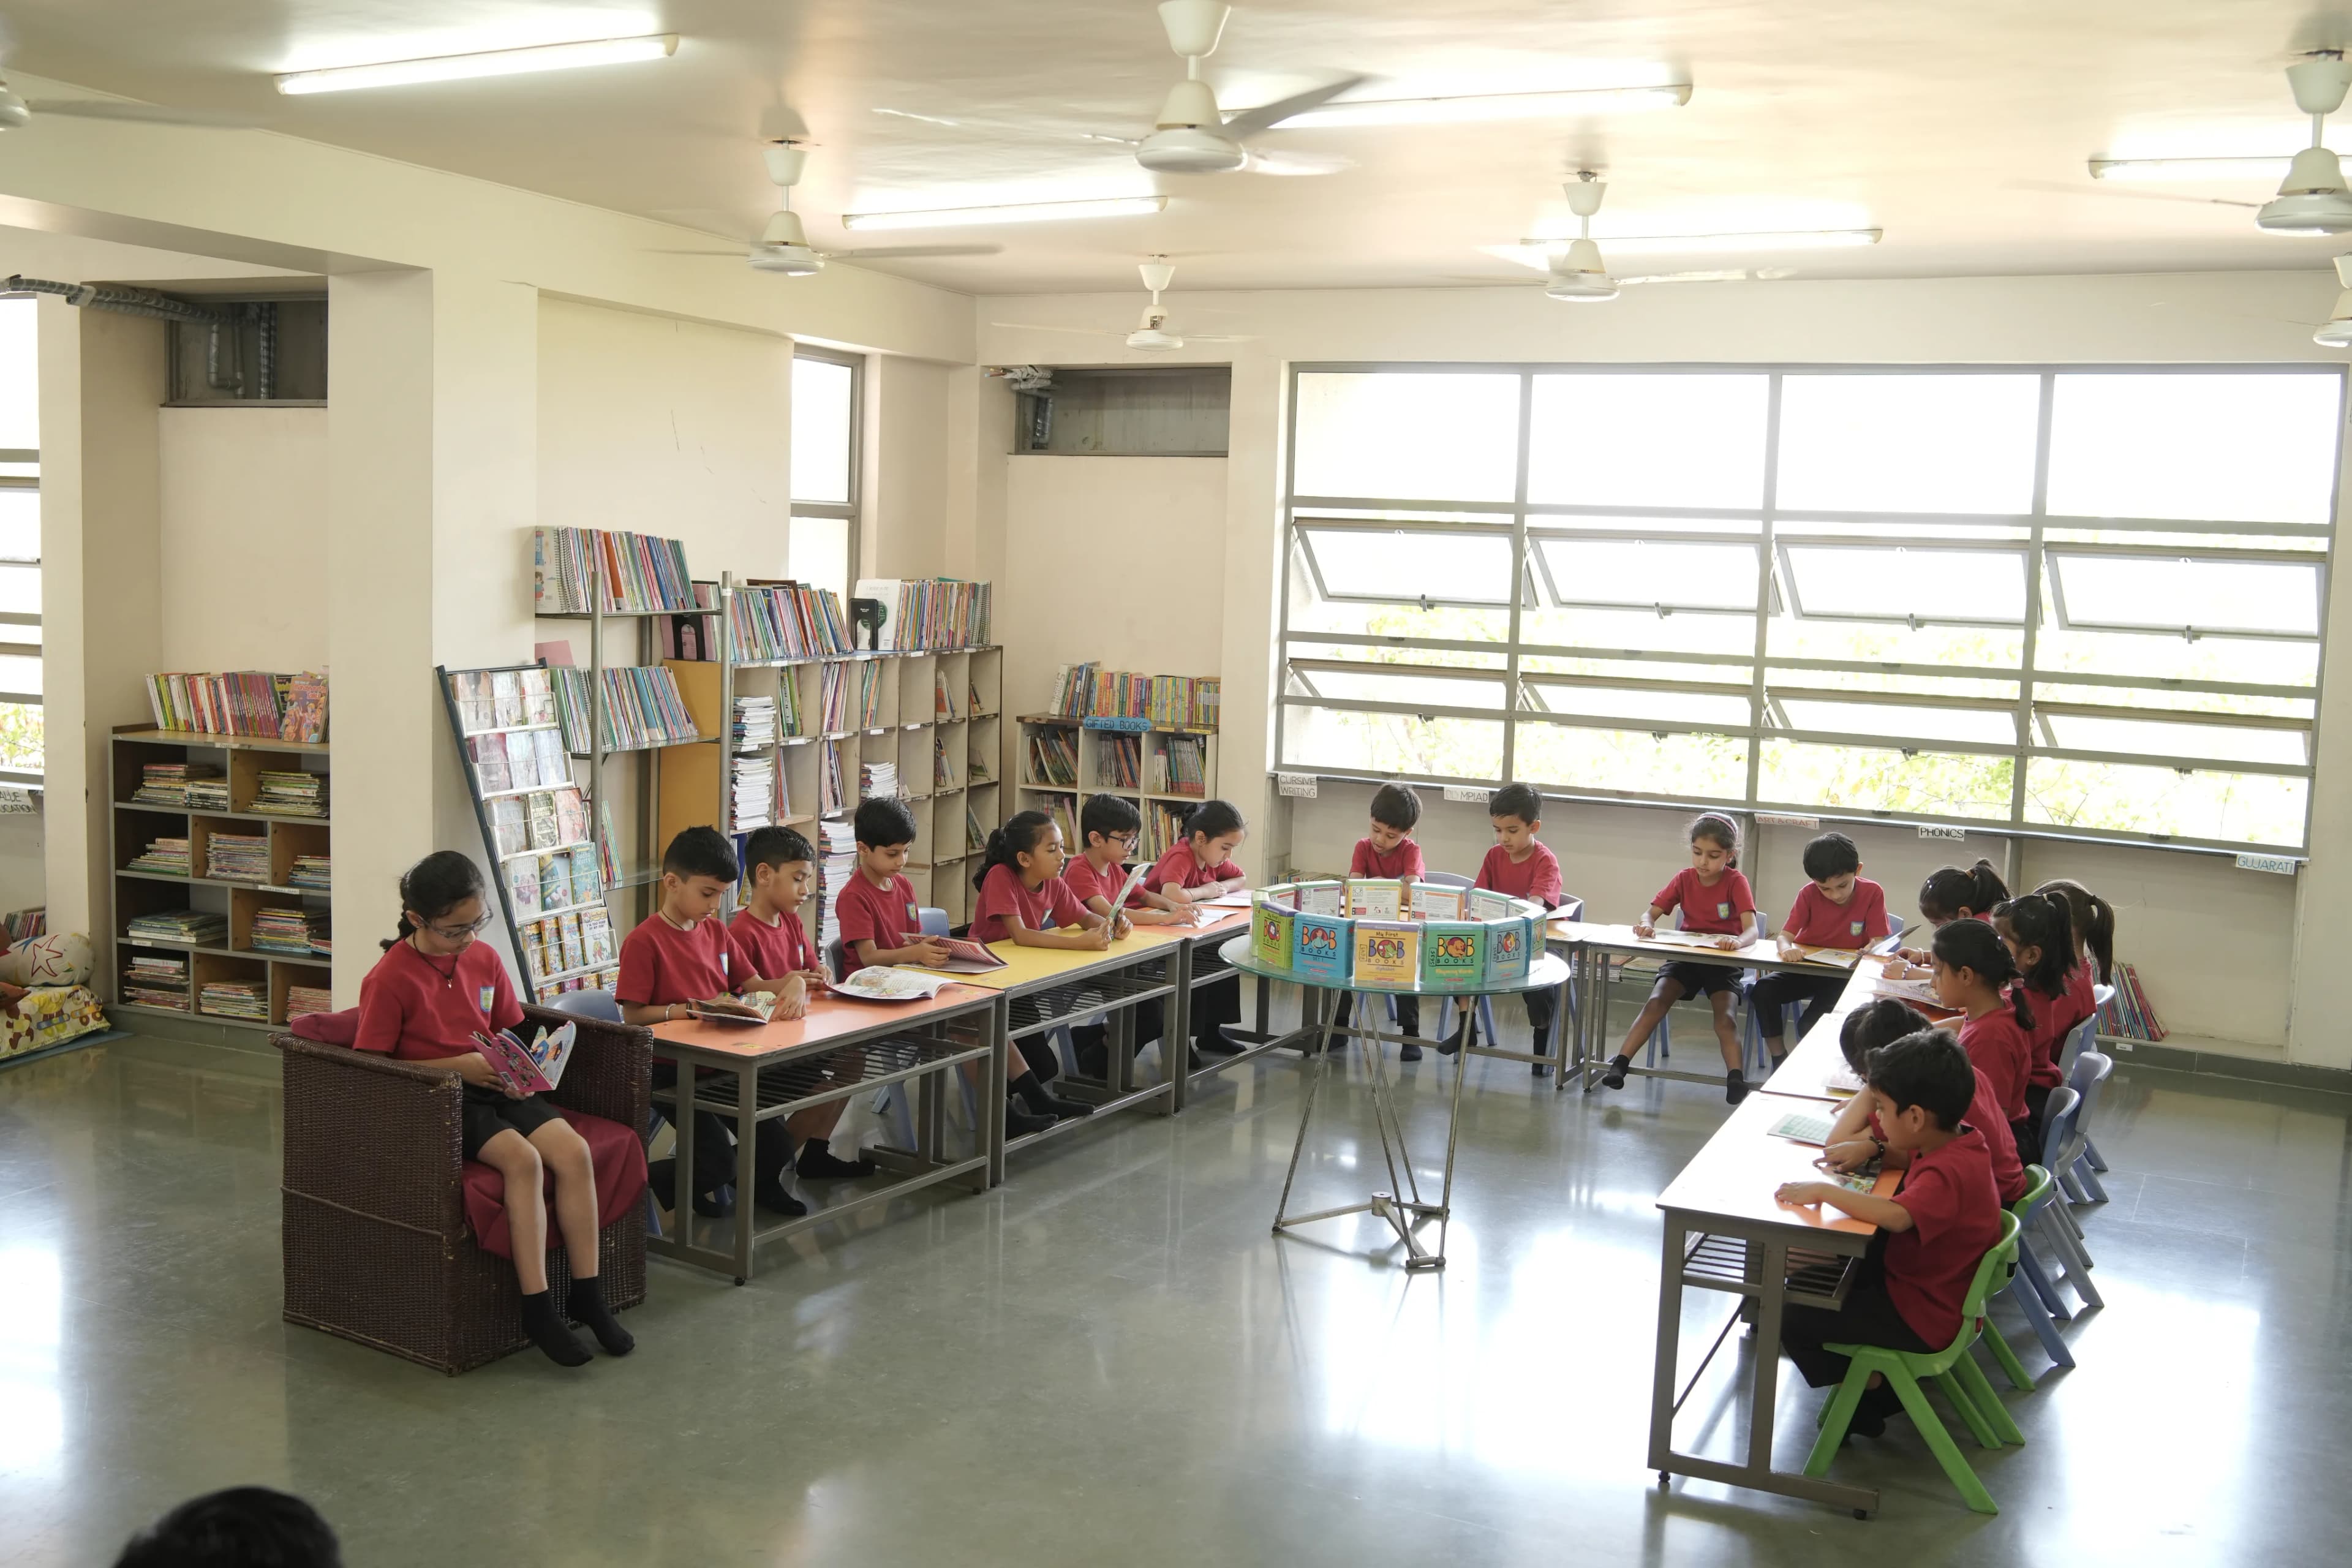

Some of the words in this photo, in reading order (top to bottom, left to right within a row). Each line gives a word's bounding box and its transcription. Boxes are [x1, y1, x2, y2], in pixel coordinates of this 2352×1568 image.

[1086, 718, 1115, 729] GIFTED
[1120, 720, 1147, 731] BOOKS
[1280, 775, 1315, 785] CURSIVE
[0, 790, 22, 802] ALUE
[1281, 786, 1315, 797] WRITING
[1785, 819, 1819, 829] CRAFT
[1920, 827, 1964, 839] PHONICS
[2237, 856, 2293, 873] GUJARATI
[1302, 926, 1336, 949] BOB
[1497, 931, 1521, 954] BOB
[1302, 946, 1336, 957] BOOKS
[1369, 938, 1405, 959] BOB
[1438, 937, 1475, 957] BOB
